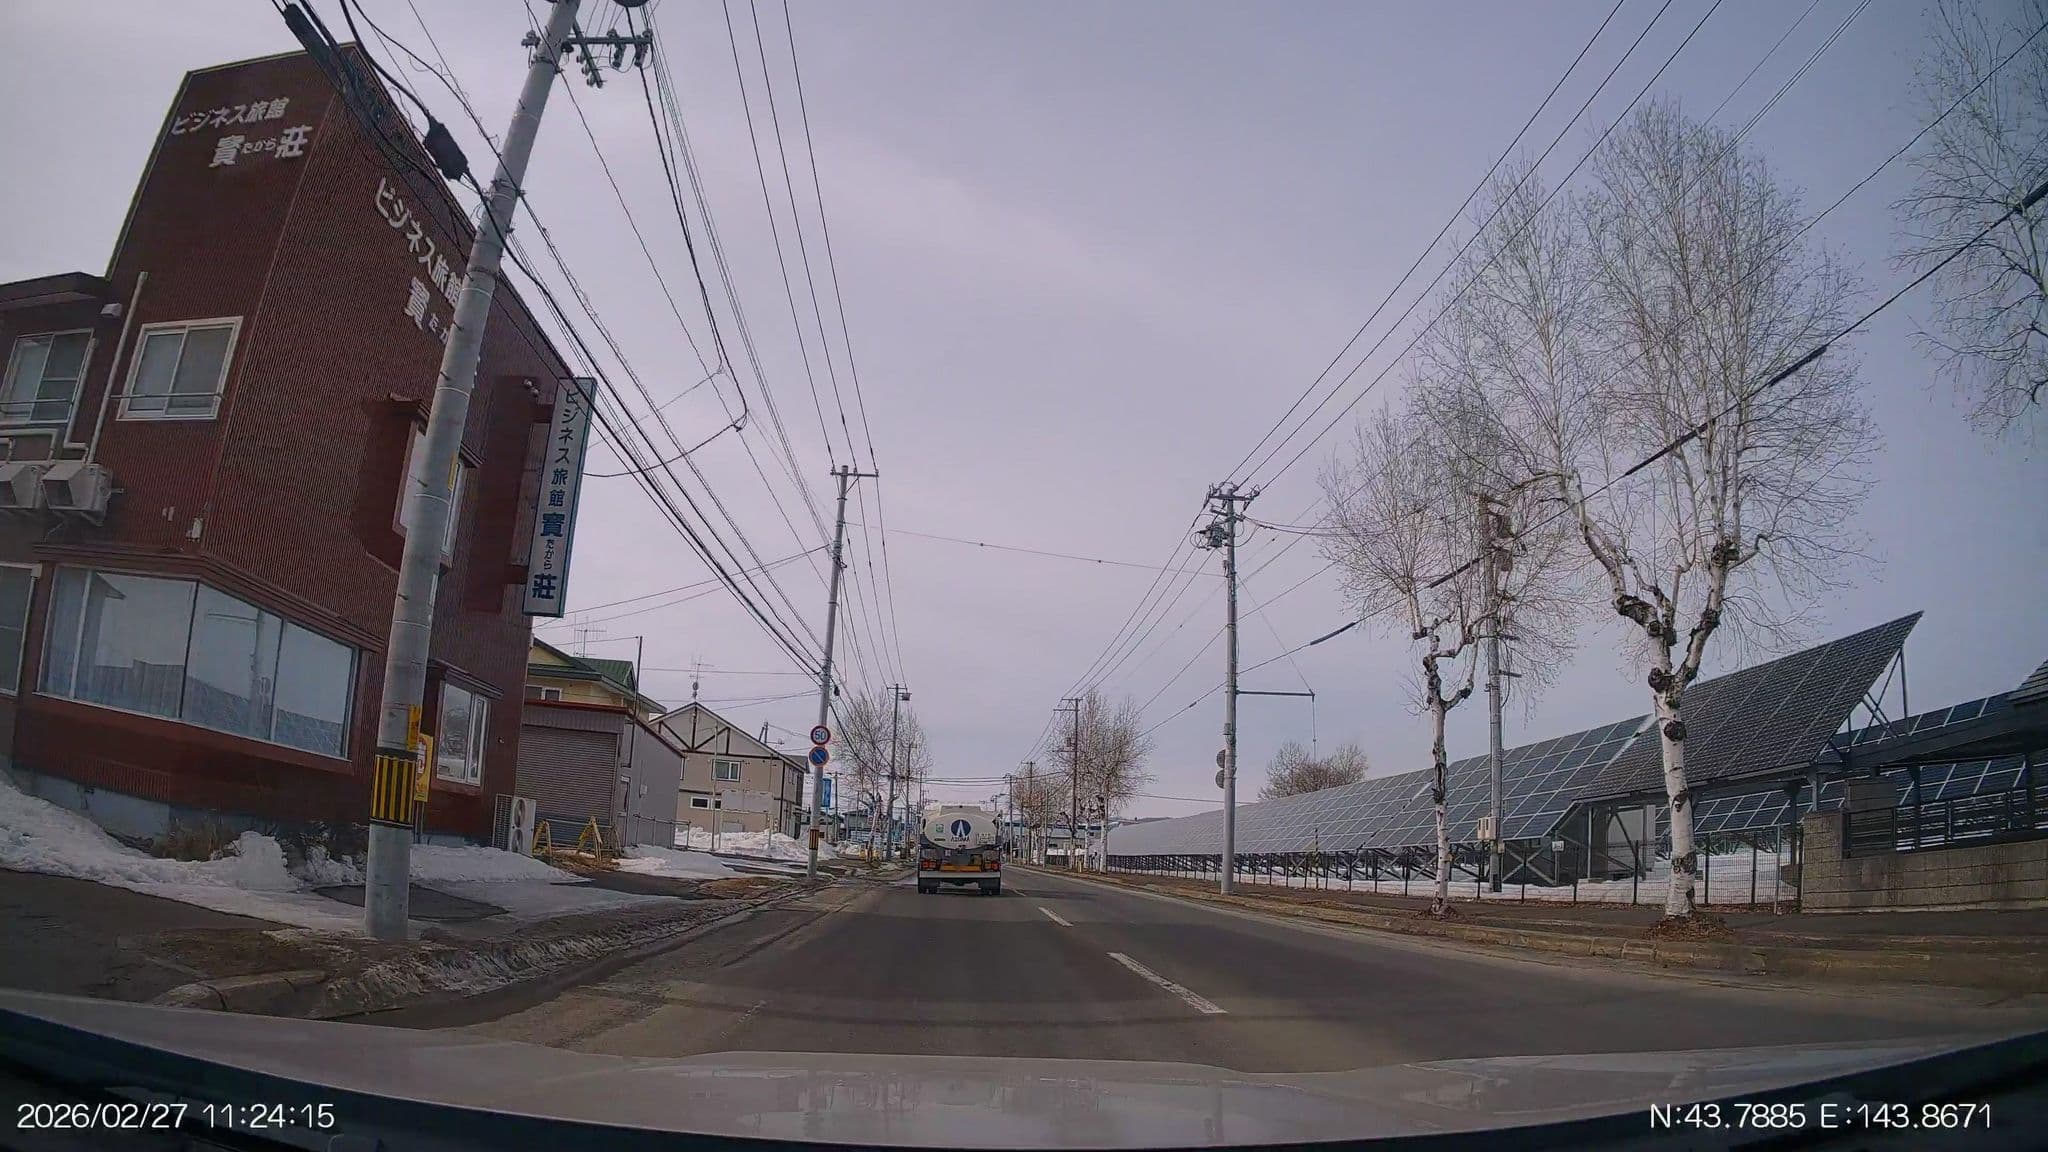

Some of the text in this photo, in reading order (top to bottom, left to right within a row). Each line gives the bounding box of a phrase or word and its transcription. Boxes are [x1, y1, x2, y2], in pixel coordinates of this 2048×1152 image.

[170, 96, 290, 136] ビジネス旅館
[815, 730, 826, 741] 50
